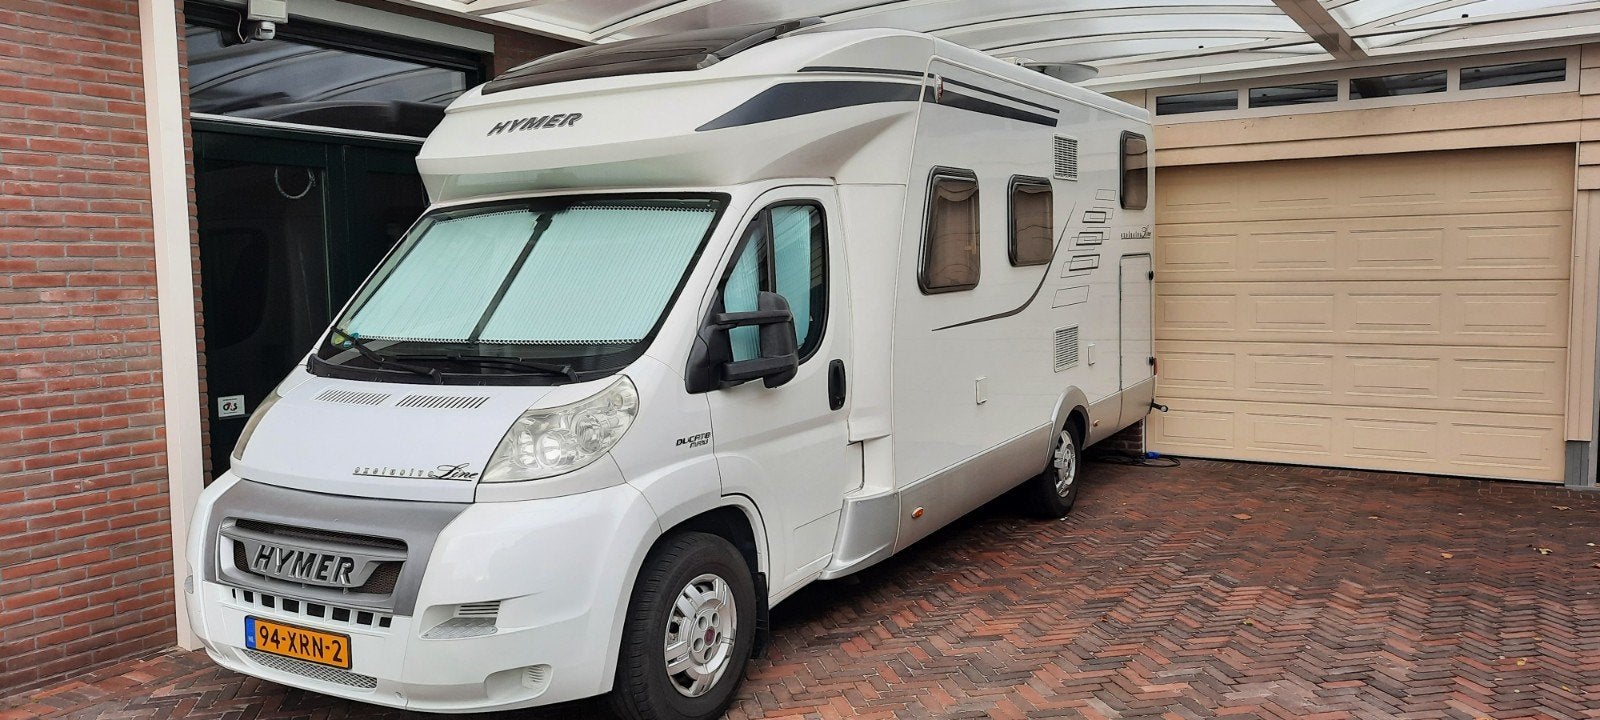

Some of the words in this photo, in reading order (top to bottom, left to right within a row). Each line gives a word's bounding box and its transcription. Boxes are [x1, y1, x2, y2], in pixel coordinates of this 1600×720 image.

[487, 112, 583, 136] HYMER
[676, 432, 710, 446] DUCATO
[435, 462, 479, 480] Line
[251, 544, 355, 585] HYMER
[259, 625, 343, 663] 94-XRN-2
